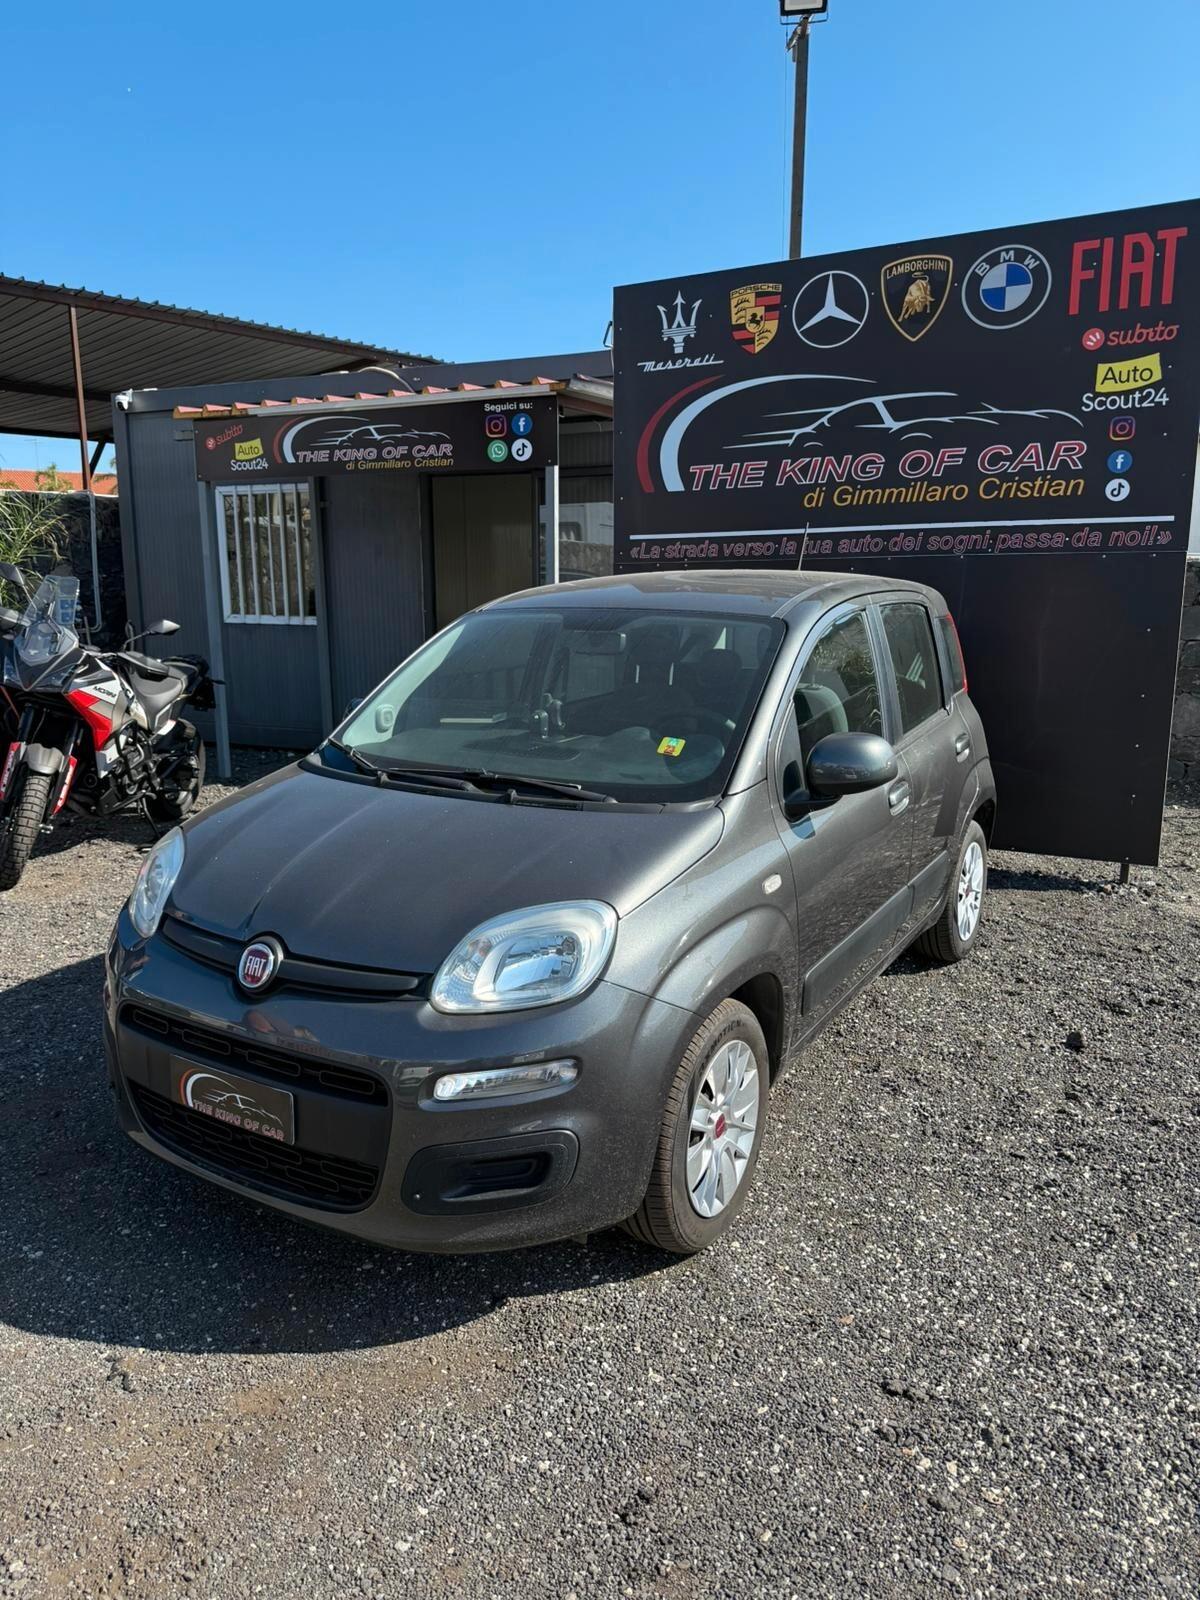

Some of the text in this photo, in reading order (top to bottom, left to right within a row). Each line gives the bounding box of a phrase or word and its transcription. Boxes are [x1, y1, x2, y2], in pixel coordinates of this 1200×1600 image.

[886, 259, 947, 280] LAMBORGHINI
[974, 250, 1040, 277] BMW
[1068, 226, 1188, 315] FIAT
[730, 284, 782, 297] PORSCHE
[1106, 321, 1180, 346] subito
[1100, 366, 1153, 385] Auto
[484, 402, 533, 413] Seguici su:
[1081, 387, 1169, 412] Scout24
[237, 445, 260, 457] Auto
[296, 443, 453, 463] THE KING OF CAR
[230, 458, 269, 471] Scout24
[345, 457, 454, 470] di Gimmillaro Cristian
[690, 440, 1087, 491] THE KING OF CAR
[803, 475, 1085, 508] di Gimmillaro Cristian
[664, 540, 718, 558] strada
[722, 540, 775, 557] verso
[779, 537, 797, 556] la
[802, 537, 832, 555] tua
[837, 535, 883, 553] auto
[888, 531, 924, 552] dei
[926, 530, 991, 554] sogni
[995, 531, 1066, 554] passa
[1071, 527, 1102, 548] da
[244, 955, 267, 977] FIAT
[193, 1099, 285, 1141] THE KING OF CAR
